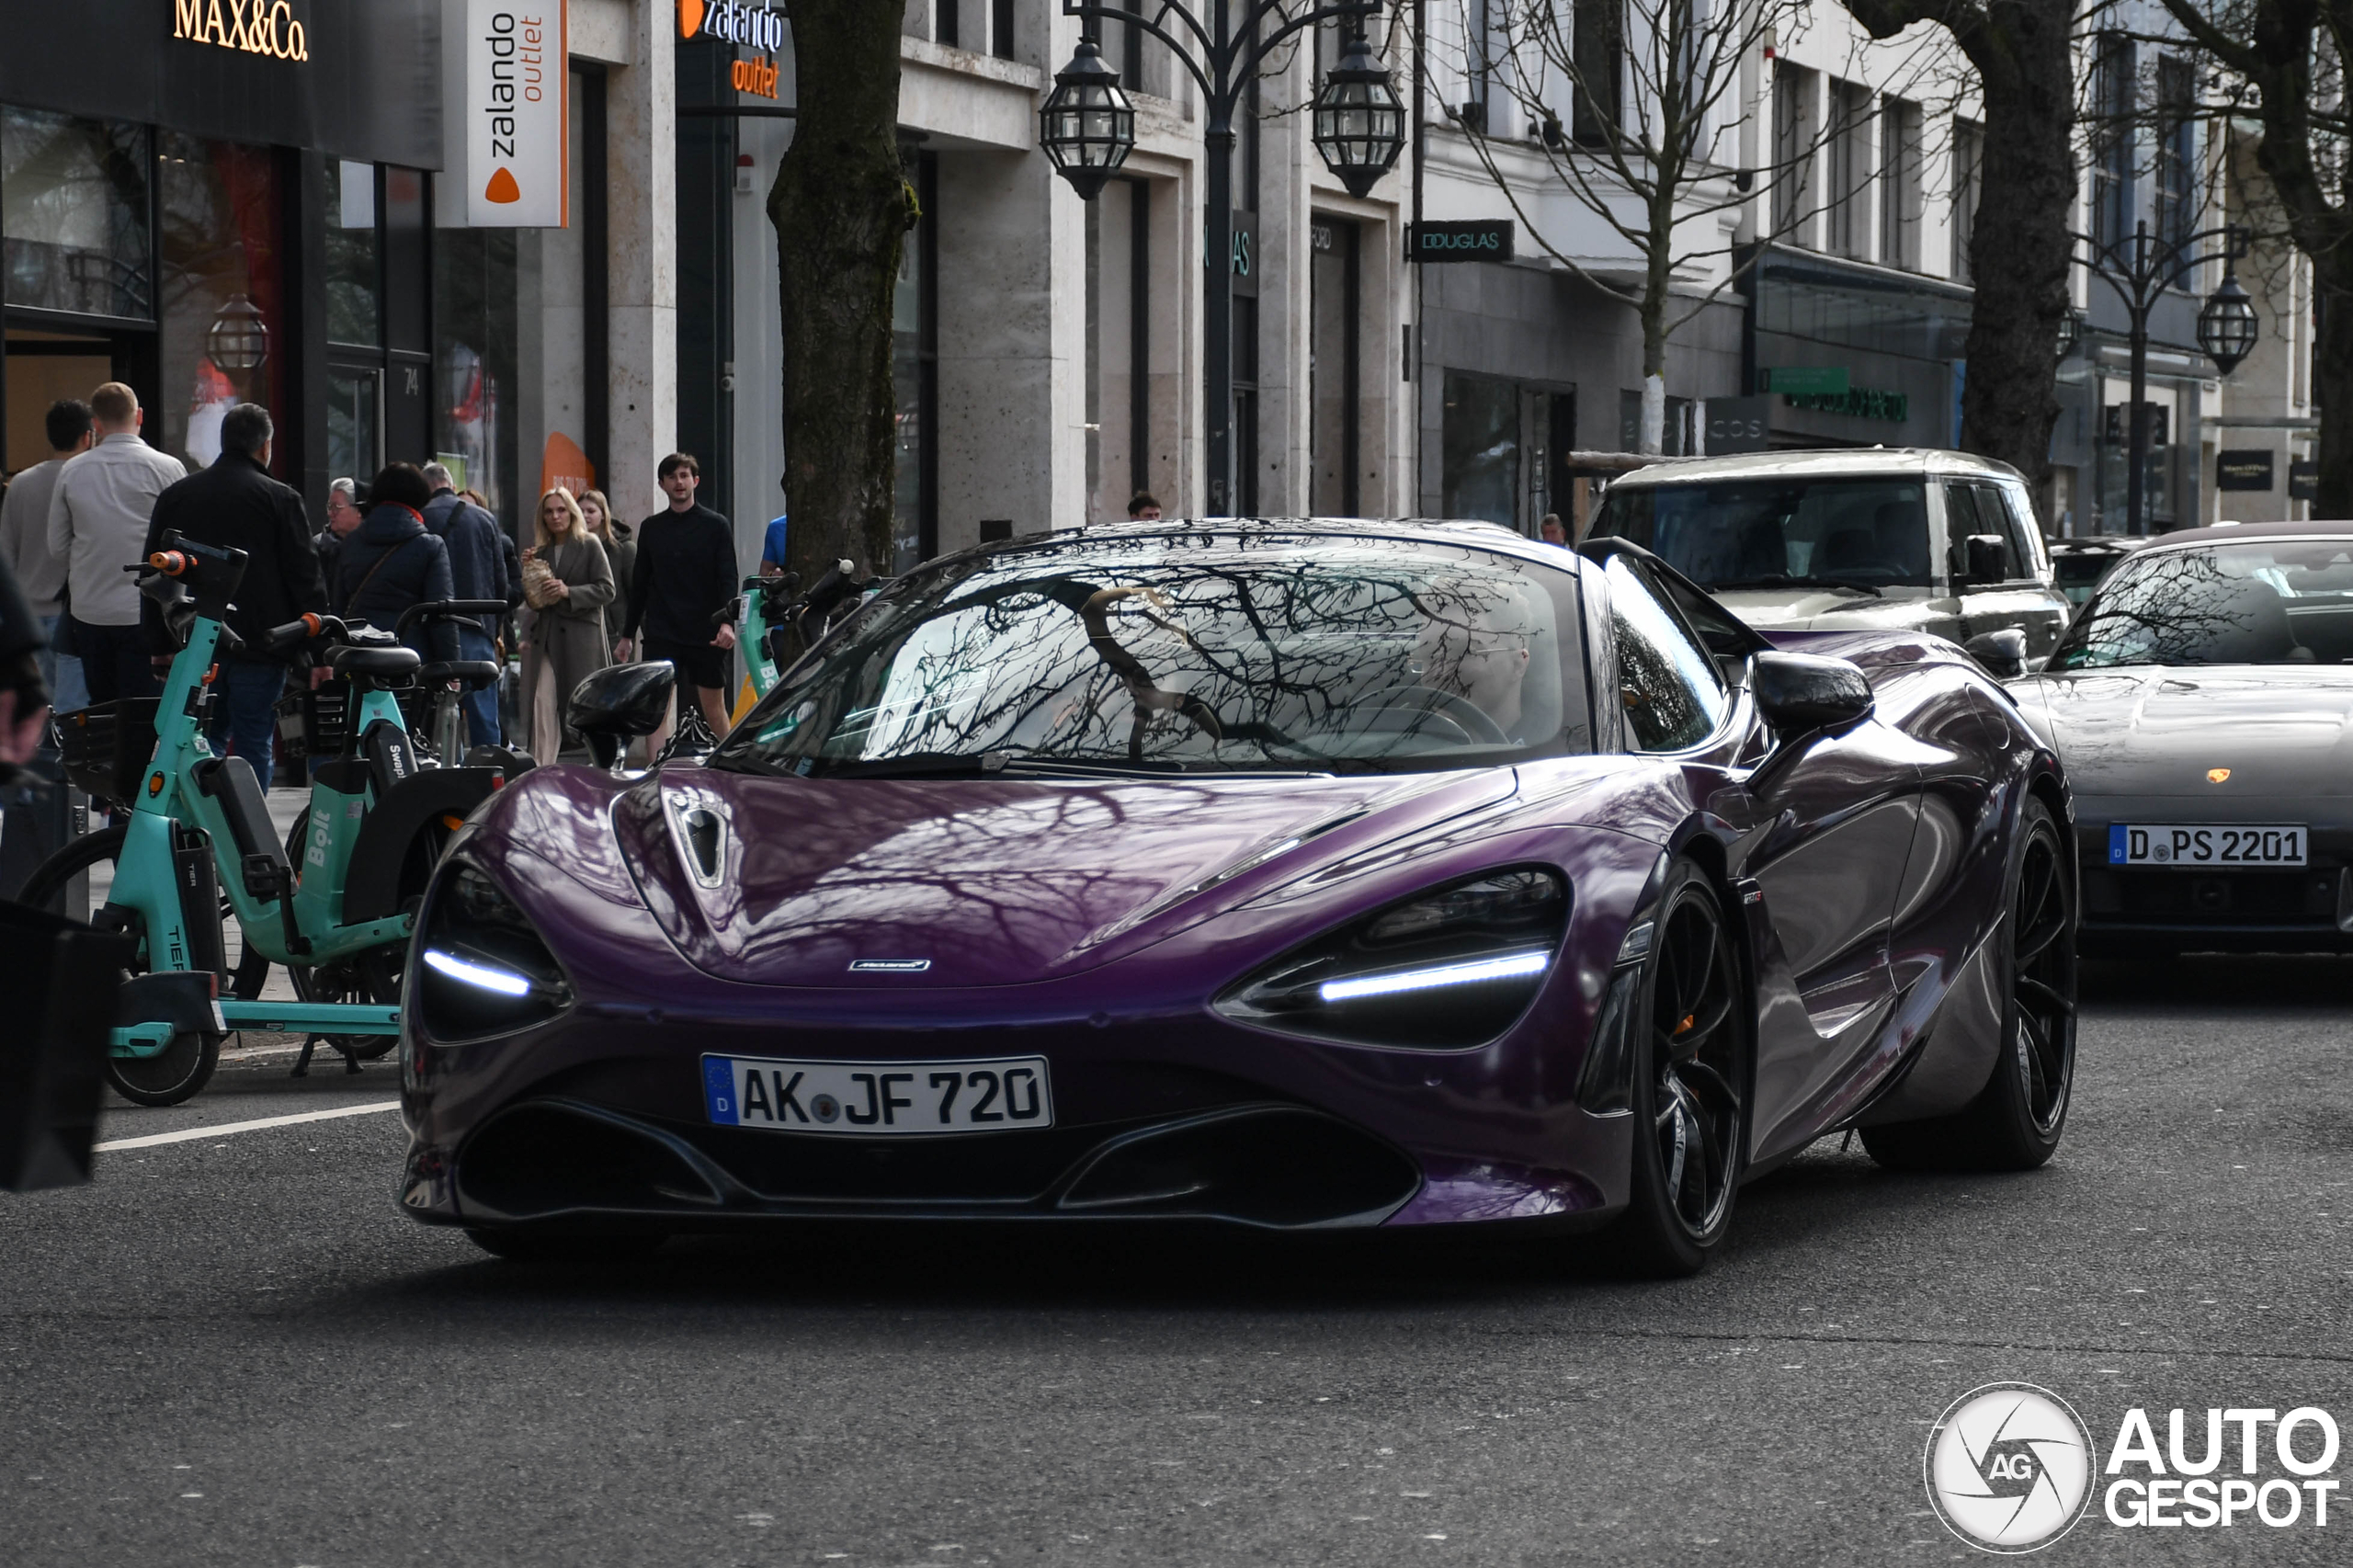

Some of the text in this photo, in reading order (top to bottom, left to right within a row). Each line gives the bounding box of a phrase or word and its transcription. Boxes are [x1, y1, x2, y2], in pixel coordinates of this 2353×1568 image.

[173, 0, 308, 62] MAX&Co.
[704, 0, 783, 52] zalando
[519, 16, 542, 102] outlet
[731, 55, 780, 99] outlet
[485, 13, 515, 158] zalando
[1422, 232, 1500, 250] DOUGLAS
[404, 368, 418, 395] 74
[1711, 420, 1762, 438] COS
[307, 809, 332, 868] Bolt
[2114, 848, 2122, 858] D
[2129, 829, 2302, 862] D PS 2201
[188, 862, 197, 887] TIER
[716, 1097, 729, 1112] D
[743, 1068, 1040, 1125] AK JF 720
